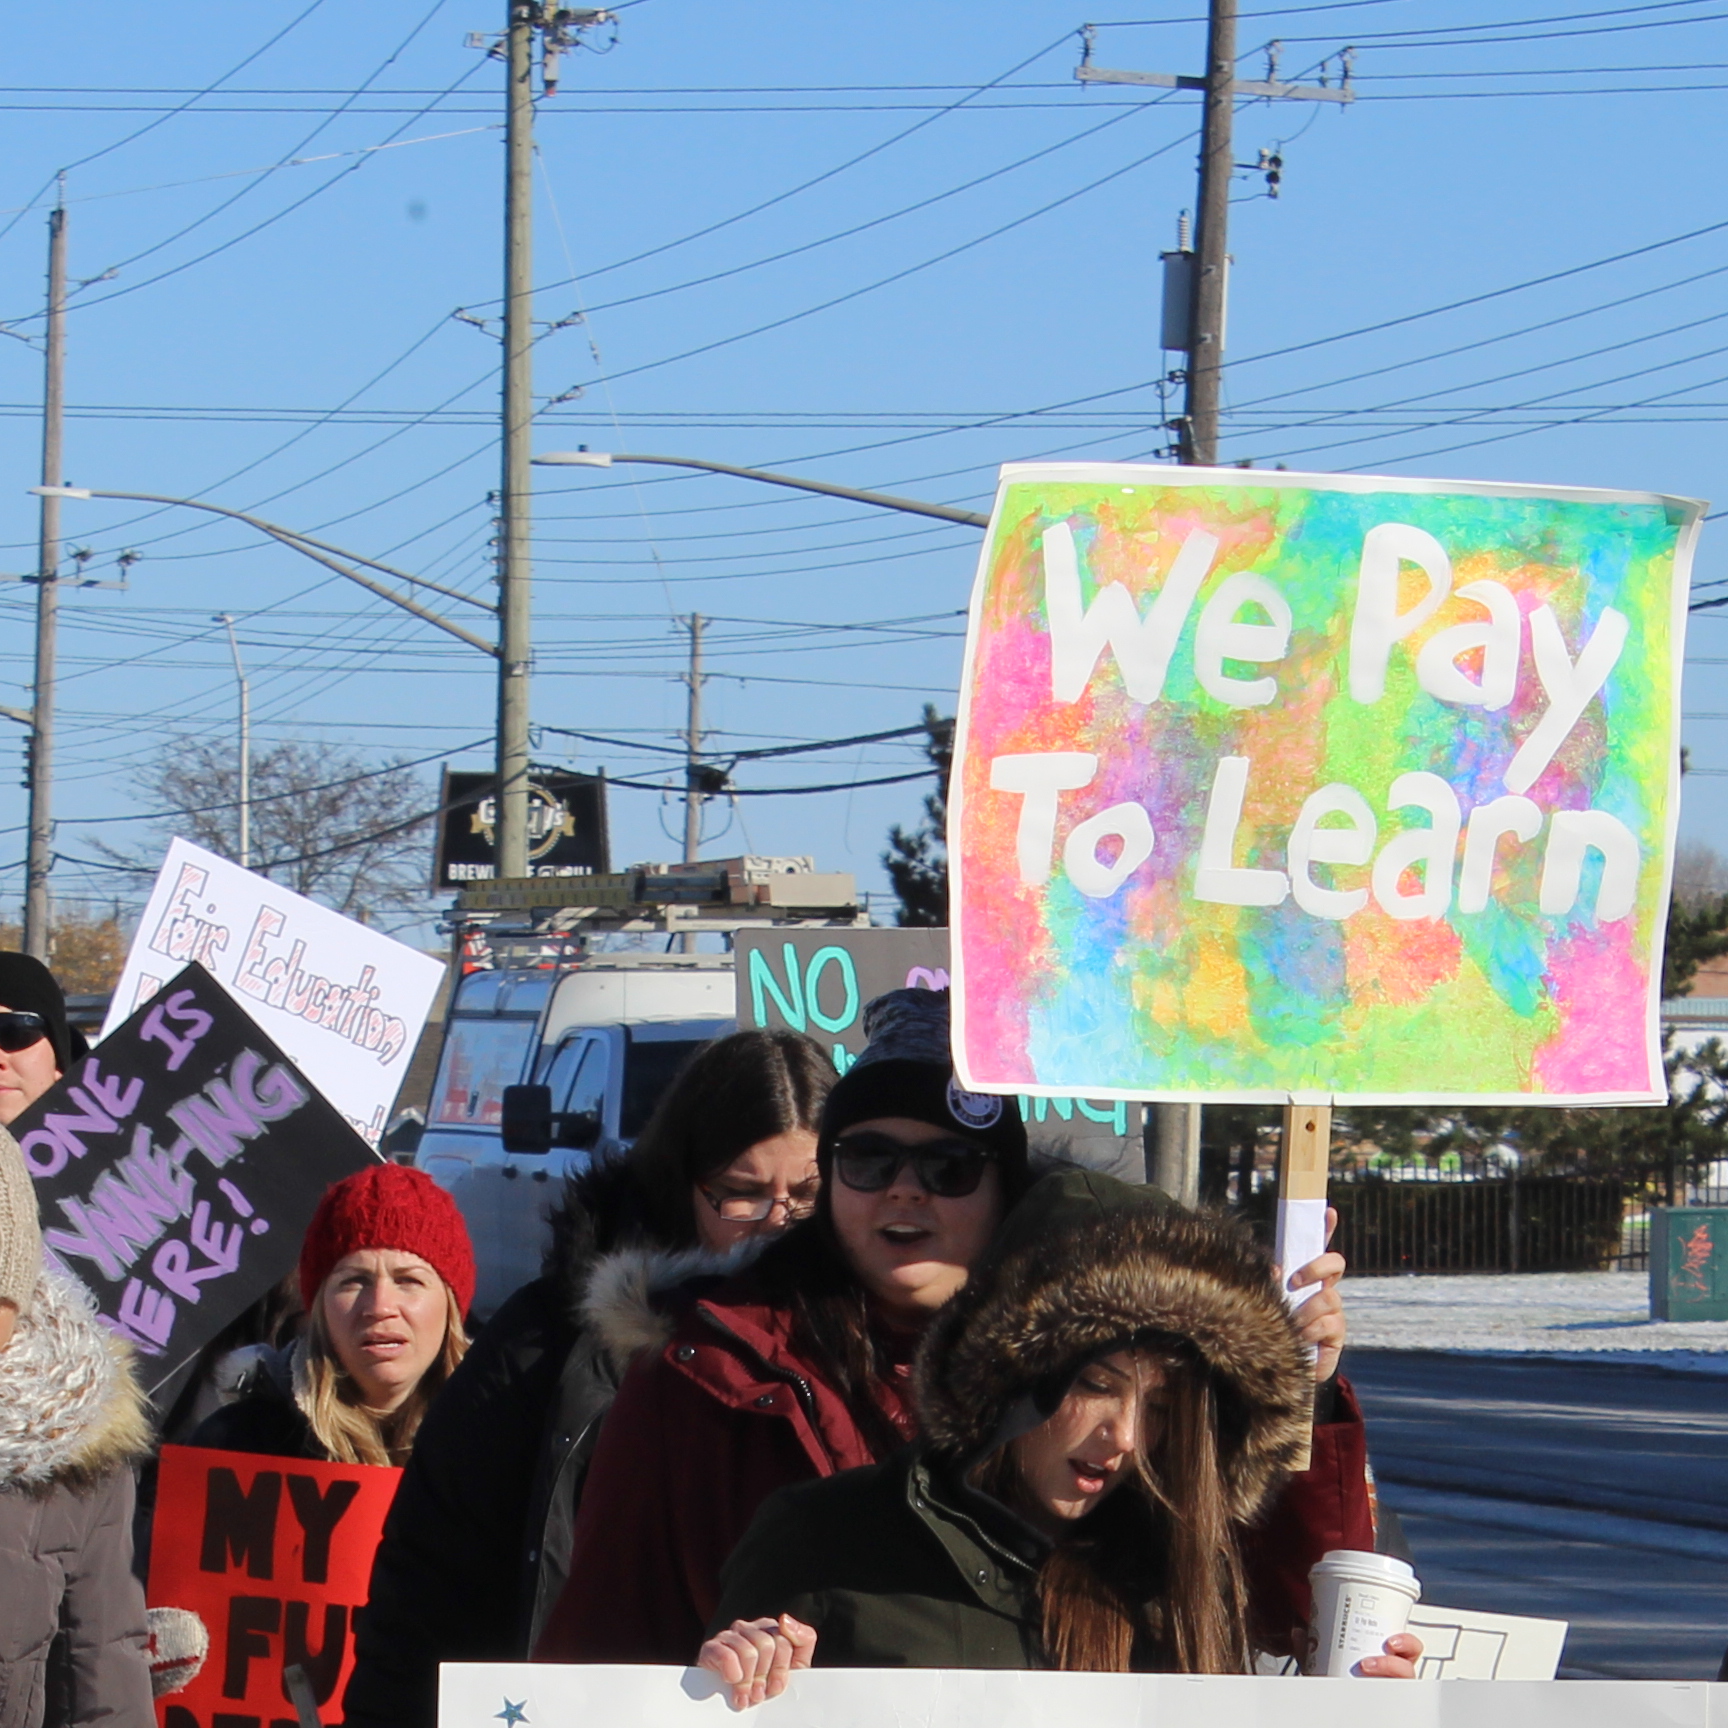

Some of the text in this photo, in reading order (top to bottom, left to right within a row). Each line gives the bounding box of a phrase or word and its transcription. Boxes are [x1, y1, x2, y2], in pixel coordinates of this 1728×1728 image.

[1043, 521, 1630, 795] We Pay
[990, 752, 1640, 921] To Learn
[140, 989, 214, 1071] IS
[149, 862, 407, 1066] Fair Education
[749, 942, 861, 1034] NO
[96, 1178, 270, 1355] ERE!
[200, 1467, 361, 1584] MY
